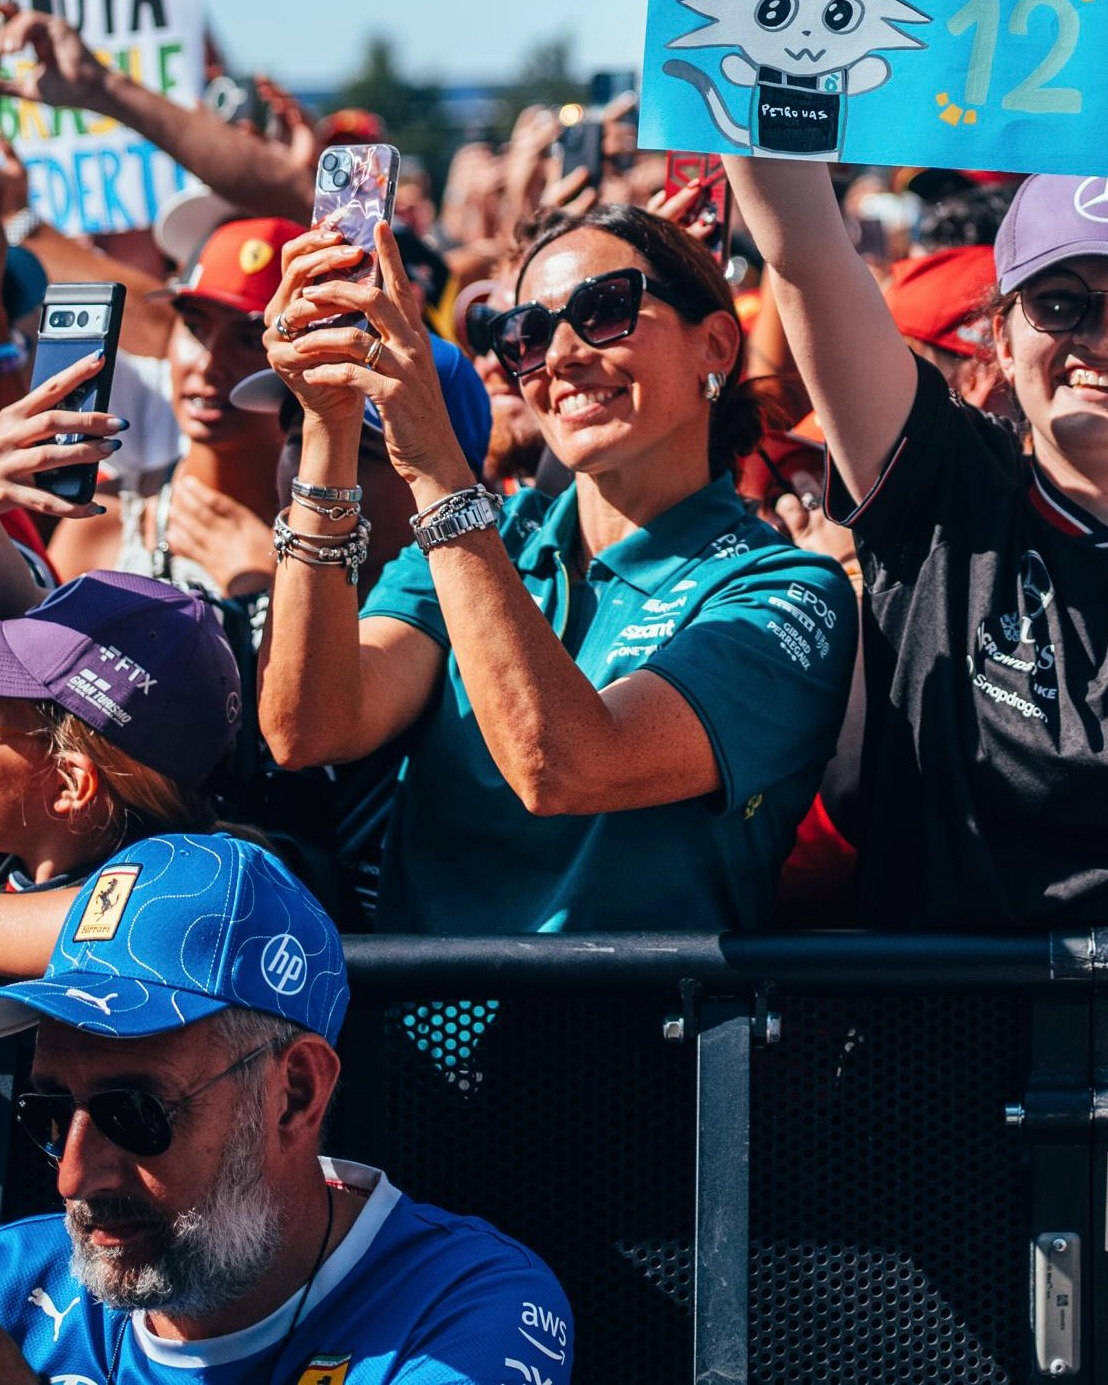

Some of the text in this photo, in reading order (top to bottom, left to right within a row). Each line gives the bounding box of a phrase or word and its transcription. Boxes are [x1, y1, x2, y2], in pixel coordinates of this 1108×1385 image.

[787, 581, 837, 629] EPOS
[766, 620, 811, 672] PERREGAUX
[783, 622, 811, 654] GIRARD
[68, 674, 98, 702] GRAN
[91, 687, 133, 725] TURISMO
[113, 657, 158, 696] FTX
[973, 674, 1049, 724] Snapdragon
[267, 935, 305, 993] hp
[521, 1301, 568, 1347] aws
